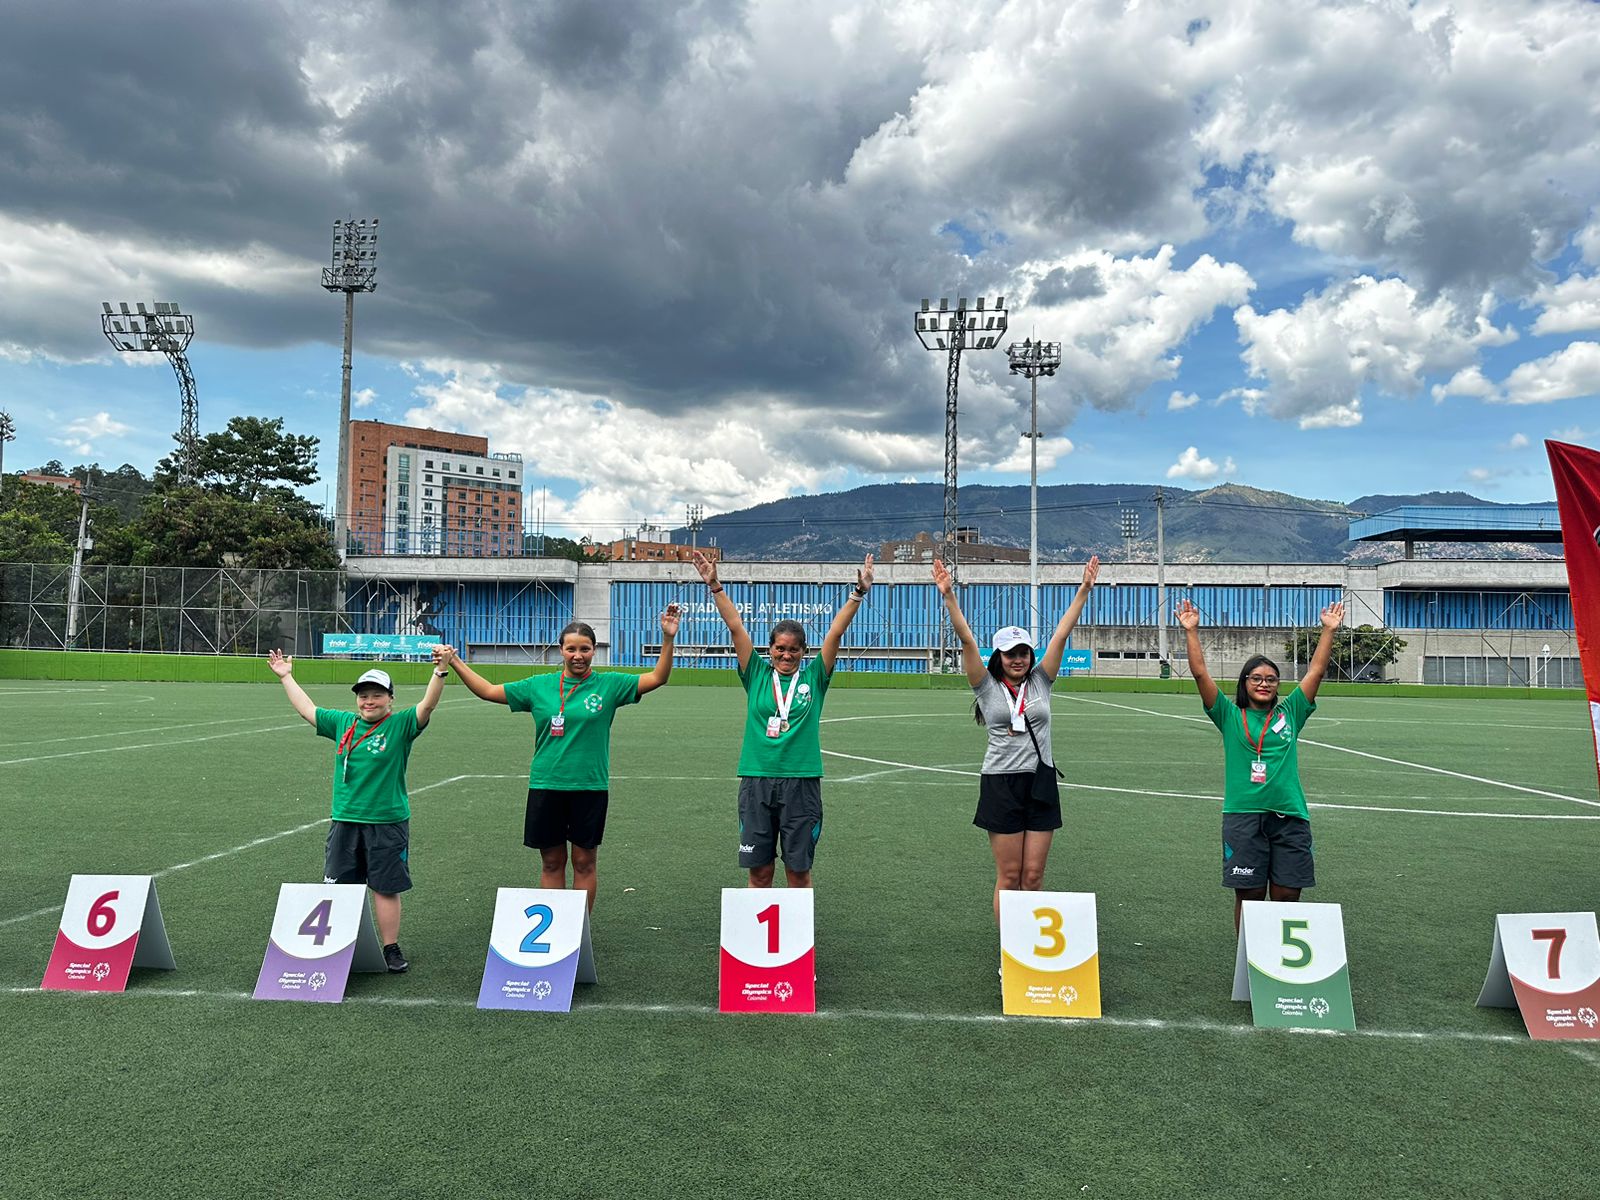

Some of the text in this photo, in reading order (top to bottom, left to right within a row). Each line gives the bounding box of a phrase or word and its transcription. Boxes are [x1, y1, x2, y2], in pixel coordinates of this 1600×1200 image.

[736, 602, 753, 613] DE
[759, 602, 833, 614] ATLETISMO
[87, 890, 120, 937] 6
[297, 899, 333, 946] 4
[519, 904, 554, 953] 2
[756, 904, 780, 953] 1
[1032, 906, 1067, 958] 3
[1280, 918, 1314, 970] 5
[1531, 928, 1567, 979] 7
